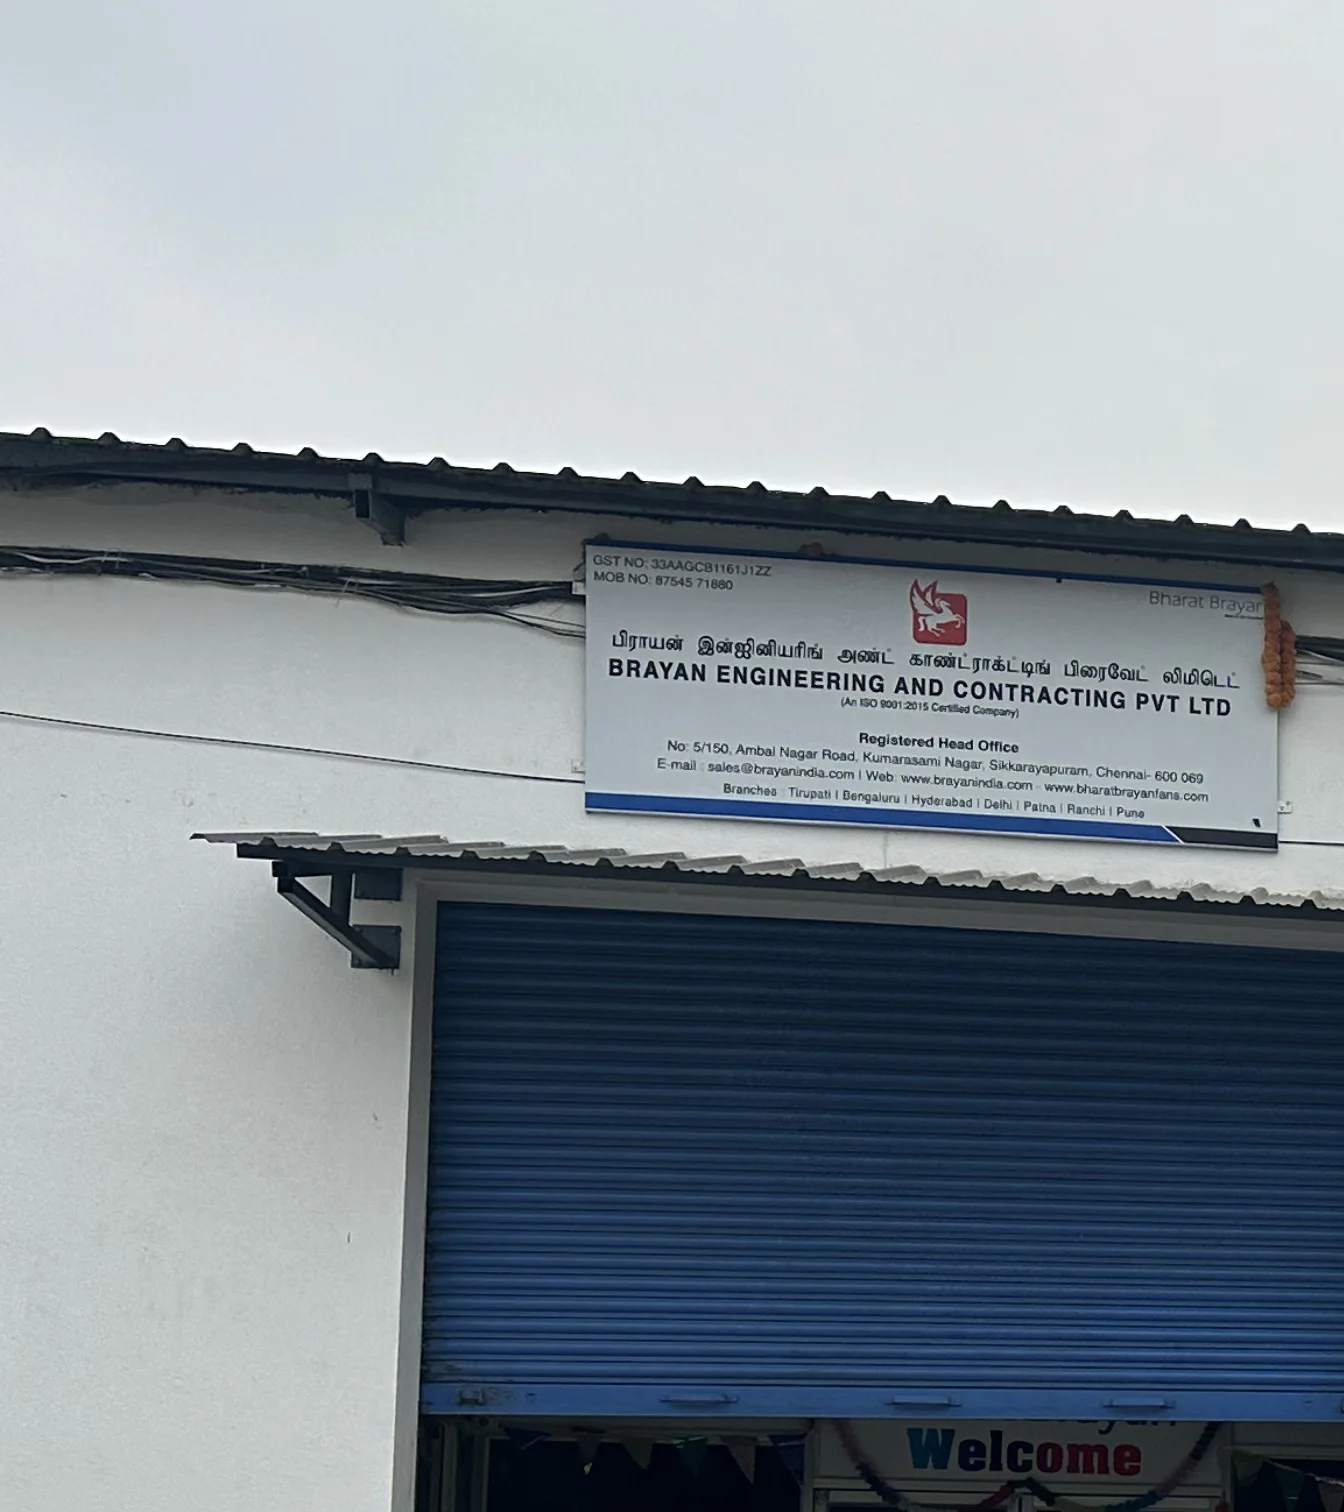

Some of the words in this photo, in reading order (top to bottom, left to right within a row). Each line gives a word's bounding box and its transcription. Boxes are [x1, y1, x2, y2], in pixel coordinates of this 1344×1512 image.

[593, 555, 621, 567] GST
[594, 571, 624, 583] MOB
[655, 575, 693, 588] 87545
[697, 578, 734, 590] 71880
[1149, 590, 1204, 609] Bharat
[612, 629, 684, 652] பிராயன்
[697, 636, 823, 660] இன்ஜினியரிங்
[838, 647, 895, 665] அண்ட்
[1064, 659, 1149, 684] பிரைவேட்
[1163, 667, 1241, 689] லிமிடெட்
[609, 658, 706, 682] BRAYAN
[717, 665, 885, 693] ENGINEERING
[894, 676, 944, 696] AND
[953, 680, 1126, 709] CONTRACTING
[1136, 692, 1180, 713] PVT
[1189, 696, 1231, 717] LTD
[859, 699, 878, 709] ISO
[859, 732, 934, 748] Registered
[938, 737, 974, 751] Head
[978, 740, 1020, 753] Office
[657, 758, 697, 771] E-mail
[707, 762, 855, 780] sales@brayanindia.com
[901, 774, 1033, 791] www.brayanindia.com
[1044, 782, 1210, 802] www.bharatbrayanfans.com
[779, 747, 817, 762] Nagar
[863, 752, 941, 767] Kumarasami
[1155, 770, 1178, 783] 600
[1181, 772, 1204, 785] 069
[788, 787, 832, 801] Tirupati
[843, 790, 900, 805] Bengaluru
[911, 794, 973, 809] Hyderabad
[984, 798, 1013, 811] Delhi
[1024, 800, 1057, 814] Patna
[1067, 803, 1106, 817] Ranchi
[1116, 806, 1145, 818] Pune
[907, 1427, 1142, 1476] Welcome
